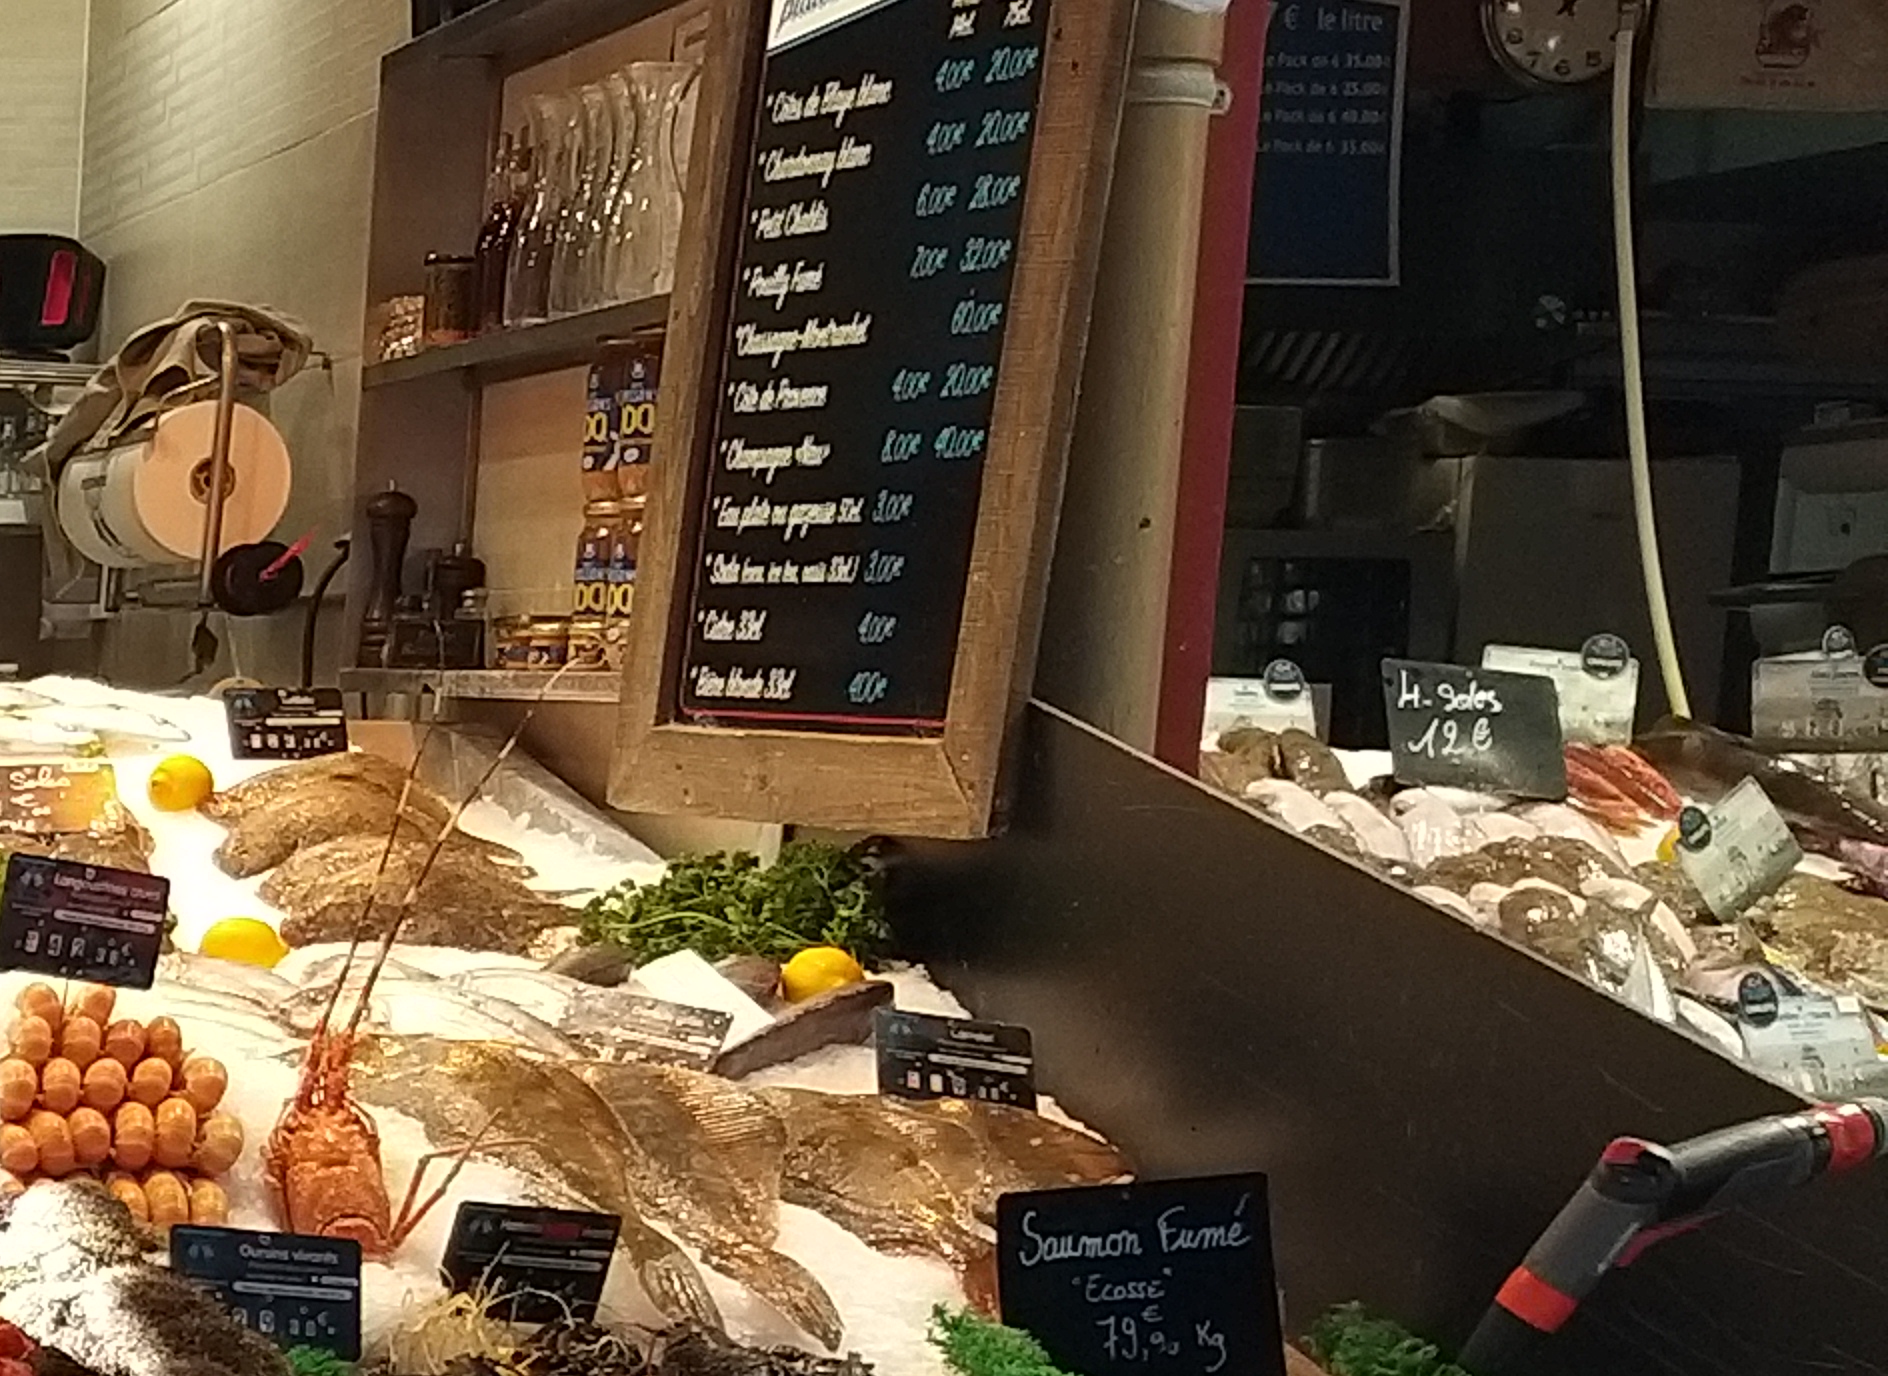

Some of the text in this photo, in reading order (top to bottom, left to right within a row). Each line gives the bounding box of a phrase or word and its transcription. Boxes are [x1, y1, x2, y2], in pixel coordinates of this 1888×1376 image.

[1019, 1193, 1253, 1268] Saumon Fumé
[1195, 1319, 1228, 1374] Kg
